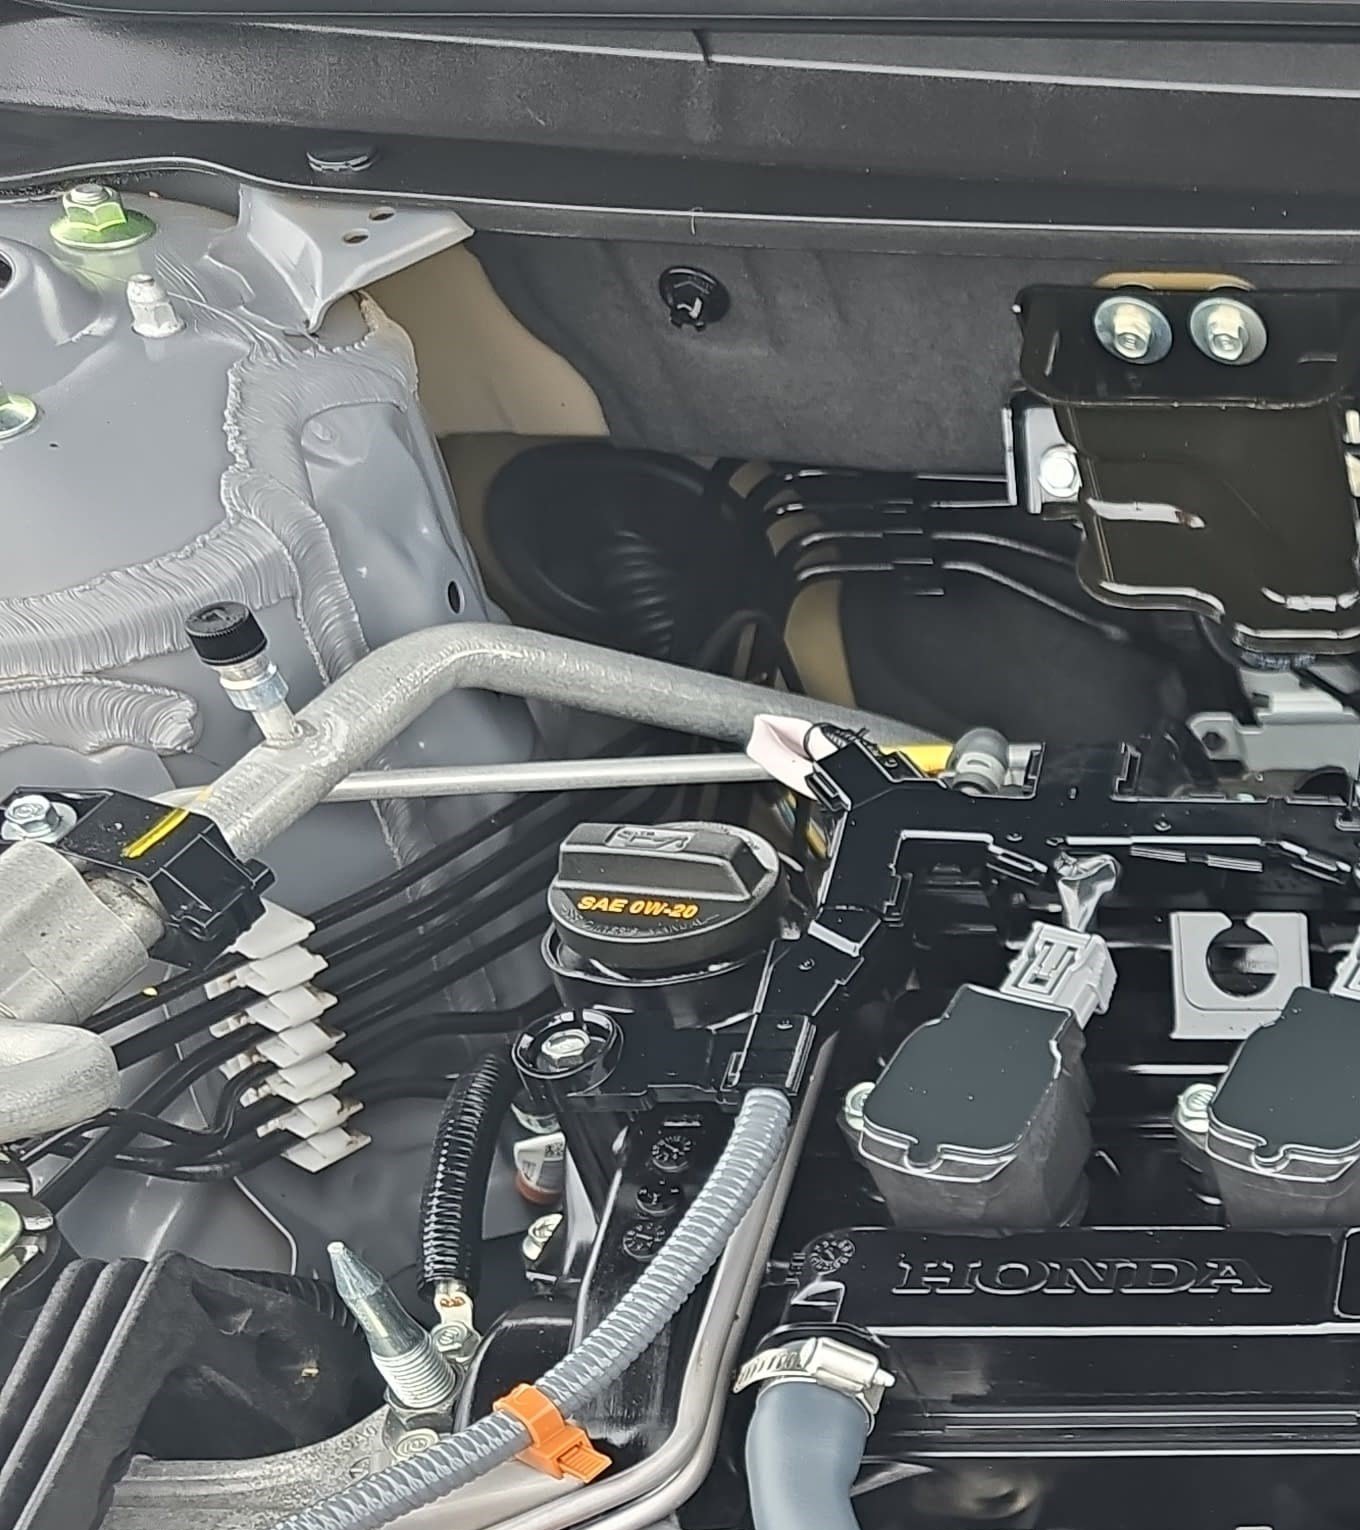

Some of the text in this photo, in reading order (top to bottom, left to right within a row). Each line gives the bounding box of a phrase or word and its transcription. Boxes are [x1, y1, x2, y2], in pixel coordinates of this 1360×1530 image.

[577, 896, 698, 919] SAE 0W-20
[892, 1256, 1272, 1295] HONDA
